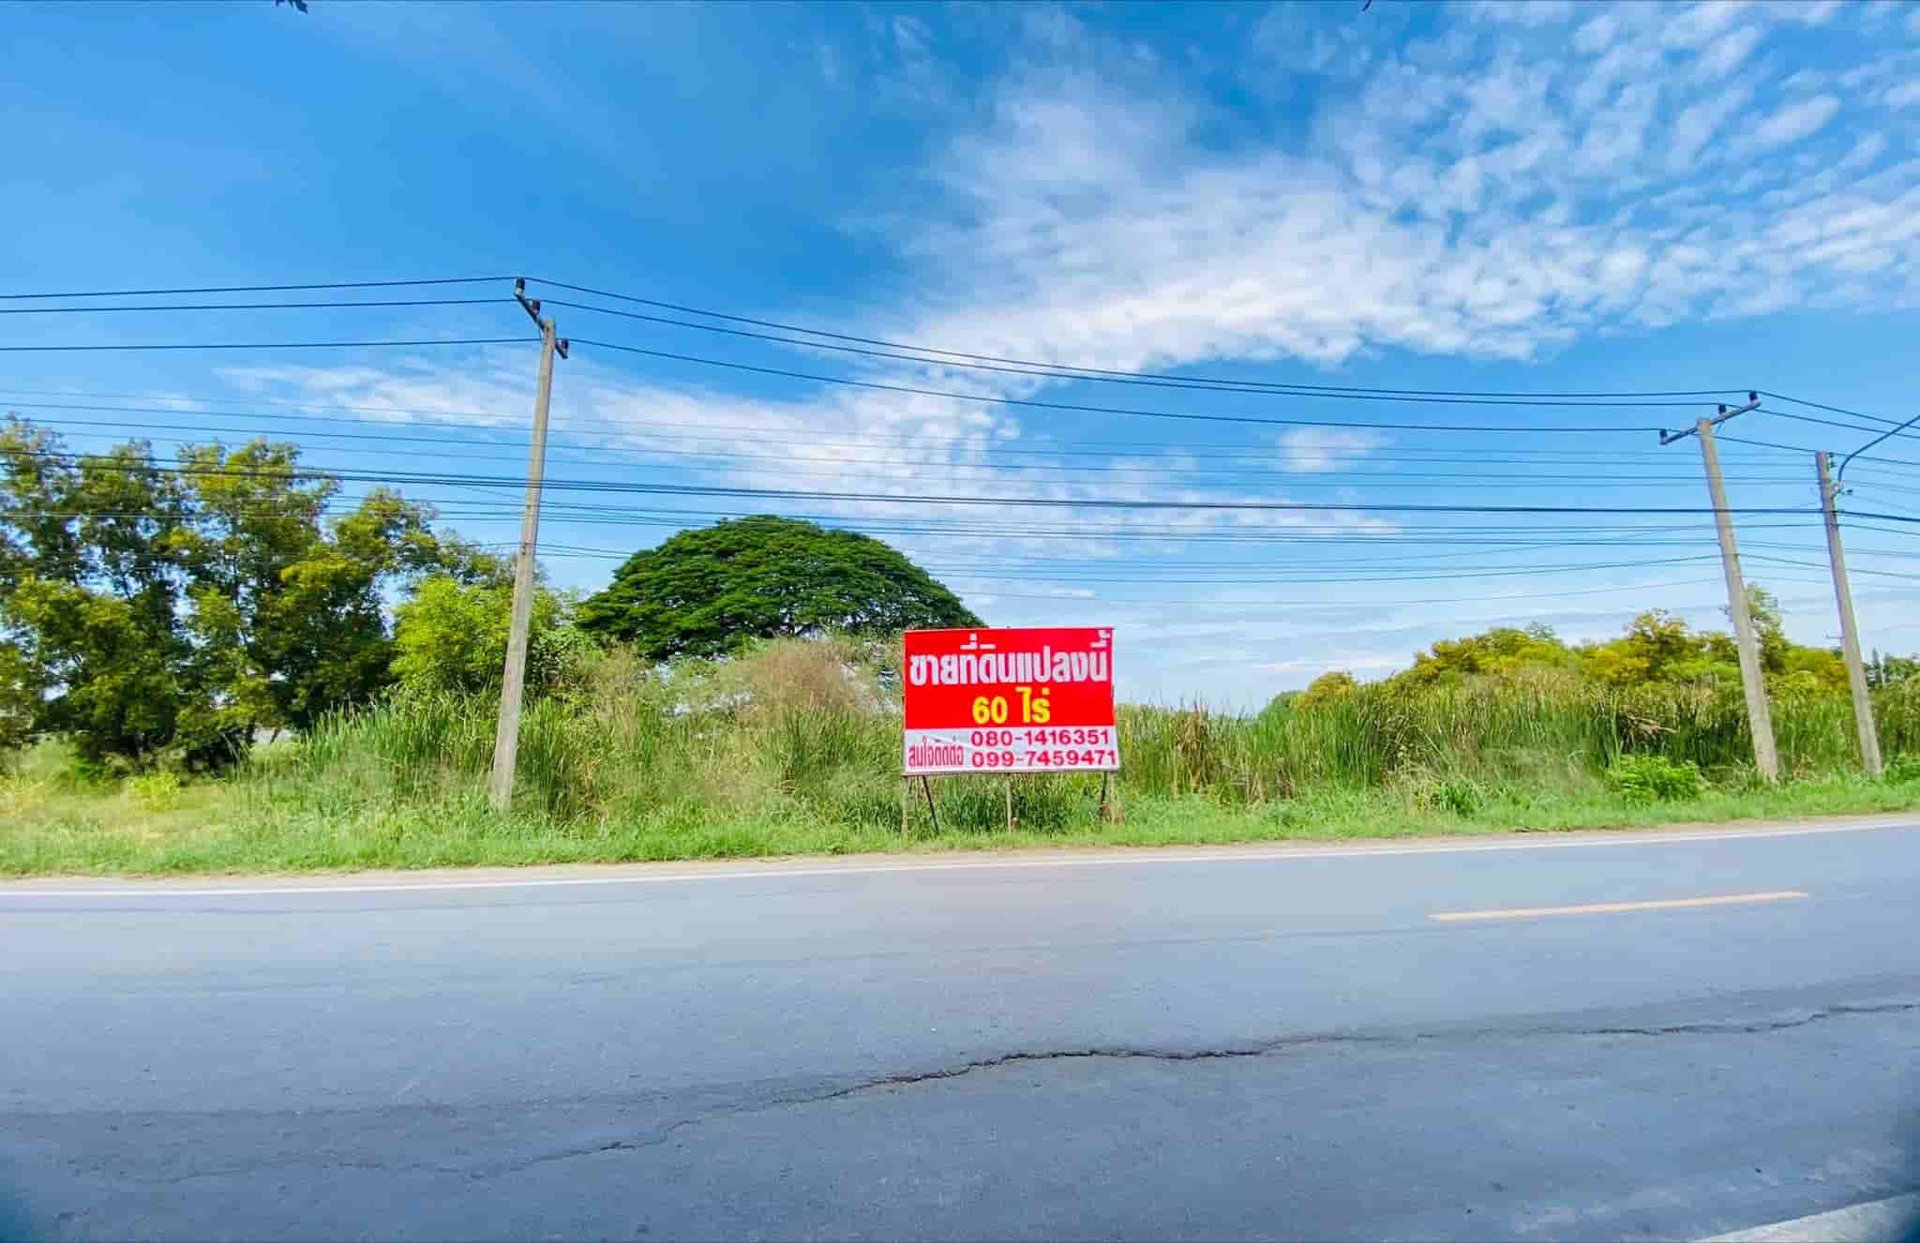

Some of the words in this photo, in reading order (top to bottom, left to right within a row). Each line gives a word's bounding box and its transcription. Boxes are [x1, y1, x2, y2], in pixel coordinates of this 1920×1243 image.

[909, 629, 1111, 686] ขายที่ดินแปลงนี้
[971, 695, 1008, 724] 60
[1015, 686, 1051, 723] ไร่
[970, 729, 1110, 747] 080-1416351
[971, 749, 1116, 768] 099-7459471
